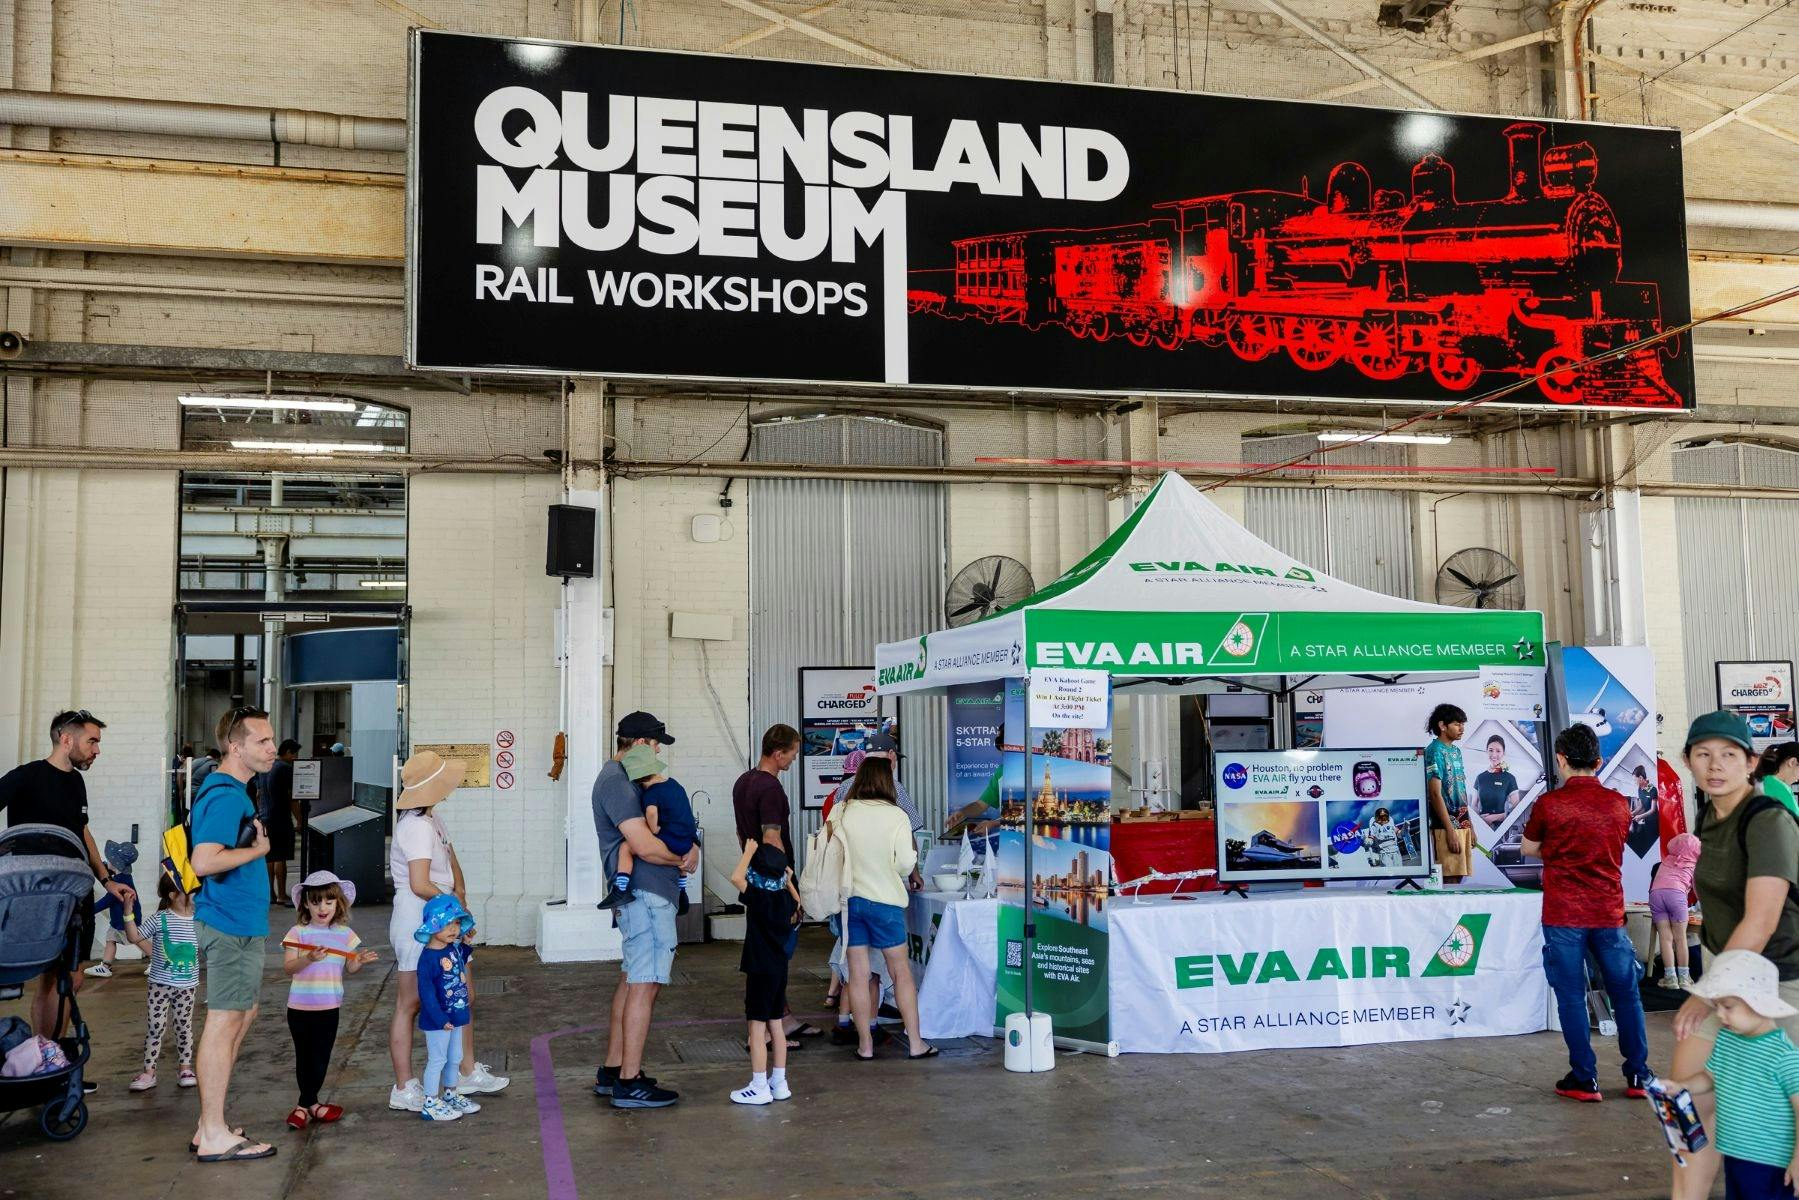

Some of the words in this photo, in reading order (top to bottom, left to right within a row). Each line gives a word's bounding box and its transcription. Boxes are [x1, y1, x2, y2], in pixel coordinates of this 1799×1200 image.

[474, 86, 1130, 202] QUEENSLAND
[475, 264, 574, 304] RAIL
[587, 269, 868, 317] WORKSHOPS
[1128, 561, 1211, 572] EVA
[1215, 562, 1278, 577] AIR
[1253, 580, 1306, 589] MEMBER
[1036, 642, 1125, 665] EVA
[1128, 642, 1203, 665] AIR
[1290, 645, 1302, 657] A
[1305, 645, 1348, 657] STAR
[1353, 644, 1433, 657] ALLIANCE
[1436, 643, 1506, 656] MEMBER
[933, 662, 938, 671] A
[938, 659, 952, 671] STAR
[952, 652, 980, 668] ALLIANCE
[980, 648, 1009, 665] MEMBER
[879, 667, 897, 686] EVA
[897, 662, 914, 682] AIR
[1731, 689, 1769, 697] CHARGED
[817, 700, 866, 709] CHARGED
[956, 738, 991, 747] 5-STAR
[956, 762, 989, 770] Experience
[1252, 764, 1291, 773] Houston,
[1306, 763, 1343, 774] problem
[1253, 774, 1269, 783] EVA
[1271, 773, 1287, 782] AIR
[1288, 773, 1299, 784] fly
[1300, 774, 1316, 784] you
[1319, 773, 1341, 781] there
[1333, 830, 1360, 842] NASA
[1037, 943, 1058, 952] Explore
[1058, 945, 1089, 956] Southeast
[1031, 952, 1048, 960] Asia's
[1049, 954, 1080, 964] mountains,
[1049, 963, 1074, 972] historical
[1075, 966, 1090, 974] sites
[1174, 950, 1300, 989] EVA
[1307, 946, 1410, 979] AIR
[1044, 971, 1056, 979] with
[1057, 972, 1069, 981] EVA
[1180, 1020, 1192, 1036] A
[1197, 1014, 1246, 1033] STAR
[1253, 1009, 1350, 1029] ALLIANCE
[1353, 1006, 1435, 1025] MEMBER
